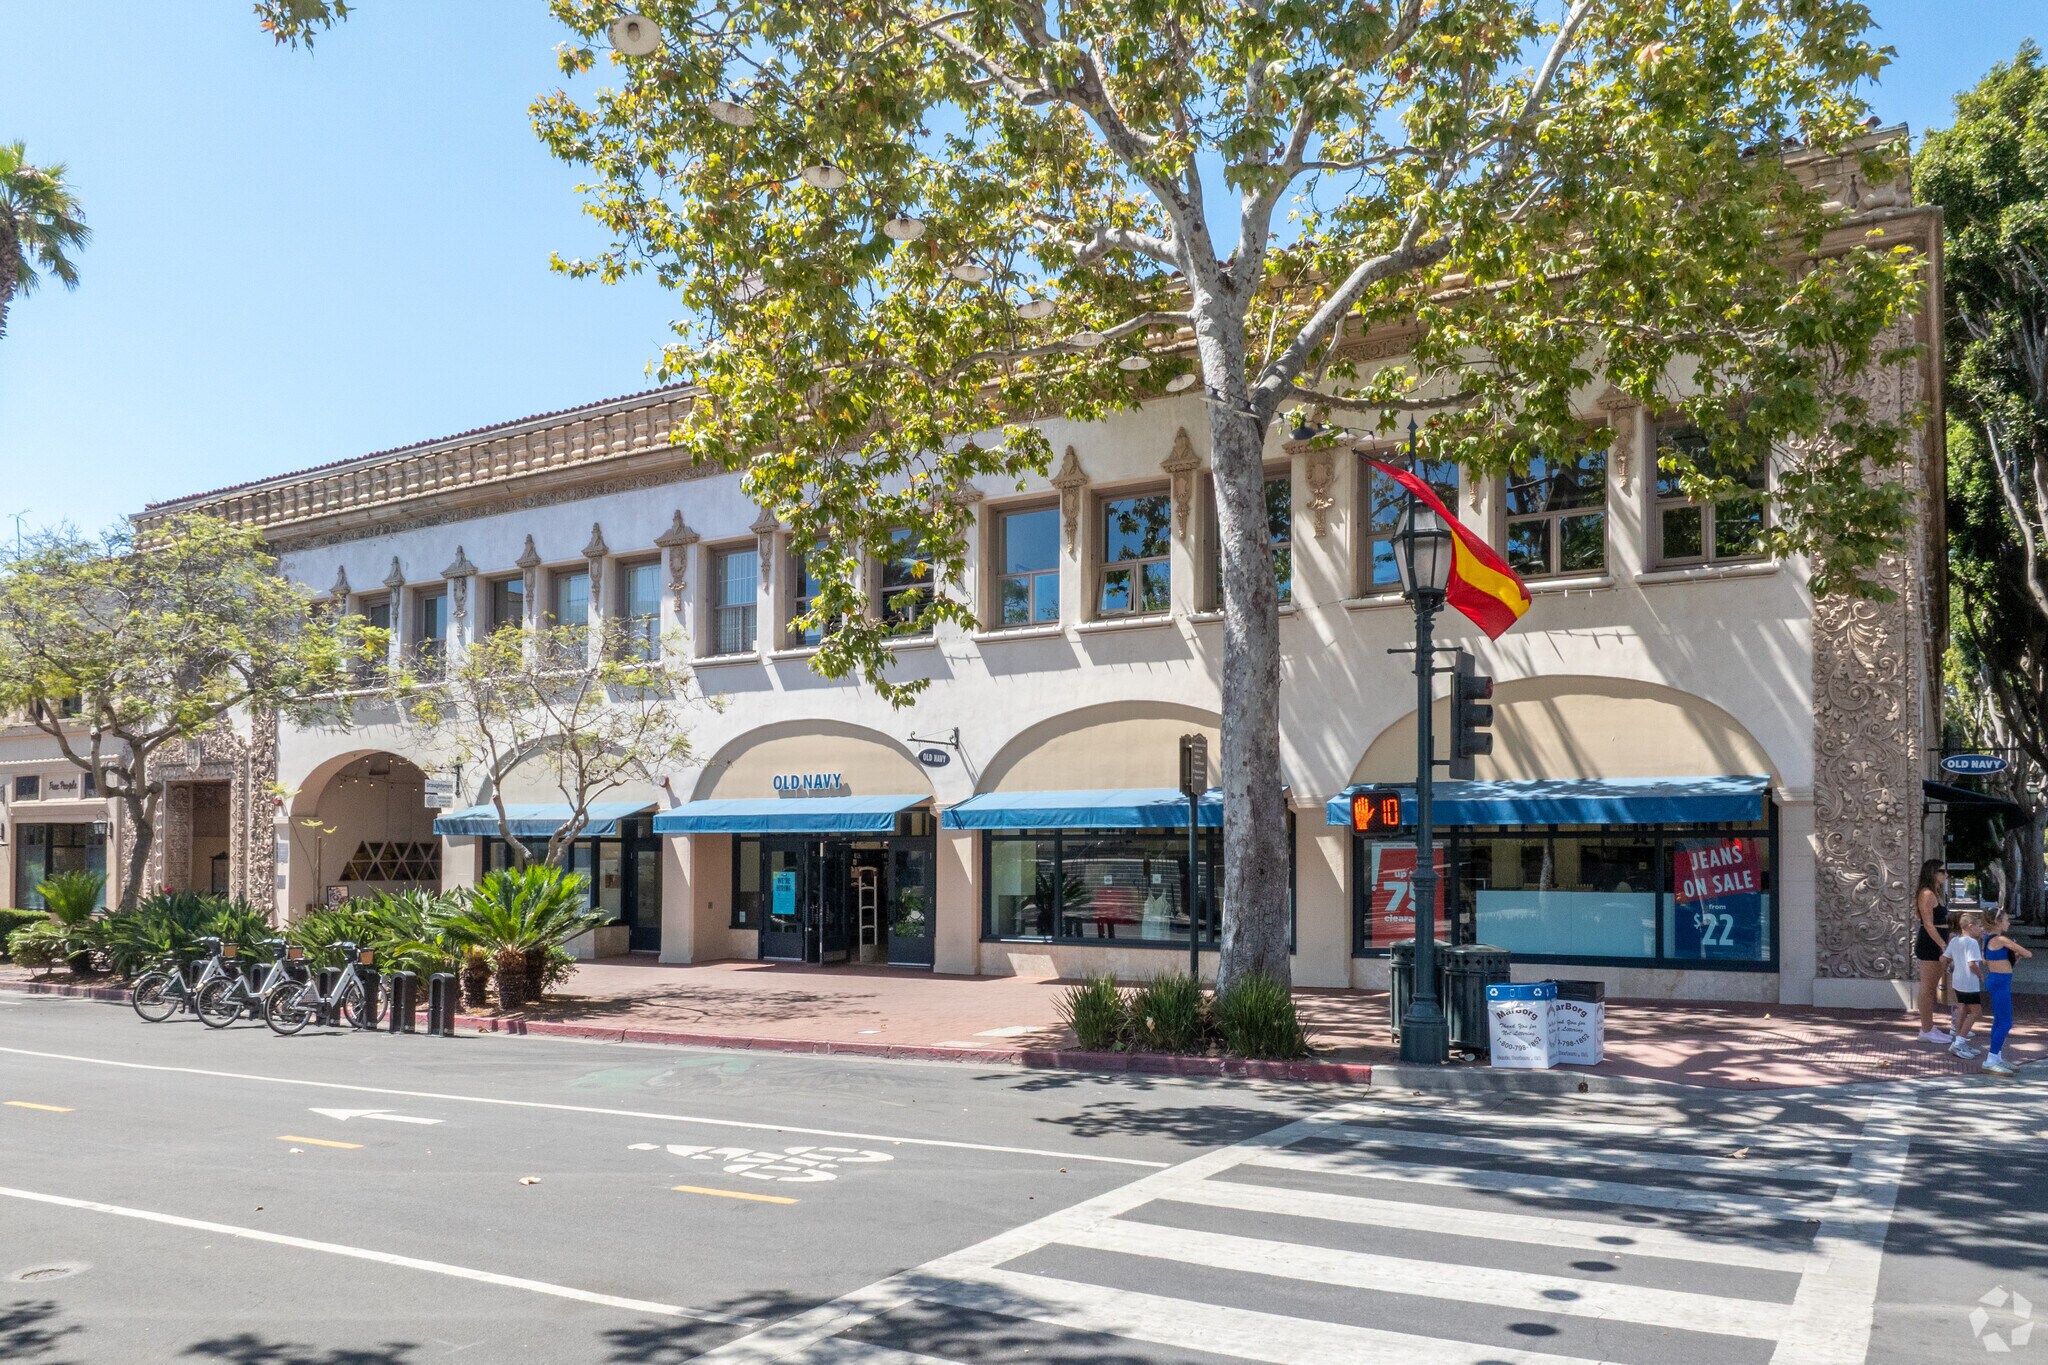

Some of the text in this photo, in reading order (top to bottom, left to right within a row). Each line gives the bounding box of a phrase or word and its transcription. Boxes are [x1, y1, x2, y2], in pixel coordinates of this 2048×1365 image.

[922, 752, 947, 763] OLD NAVY
[1947, 760, 2001, 769] OLD NAVY
[48, 779, 78, 792] Free People
[773, 773, 841, 790] OLD NAVY
[1381, 799, 1399, 825] 10
[1691, 846, 1743, 871] JEANS
[777, 877, 791, 885] WE'RE
[1394, 871, 1407, 879] up
[1683, 869, 1754, 898] ON SALE
[1693, 913, 1734, 946] $22
[1555, 1002, 1588, 1018] arBorg
[1496, 1036, 1542, 1051] 1-800-798-1852
